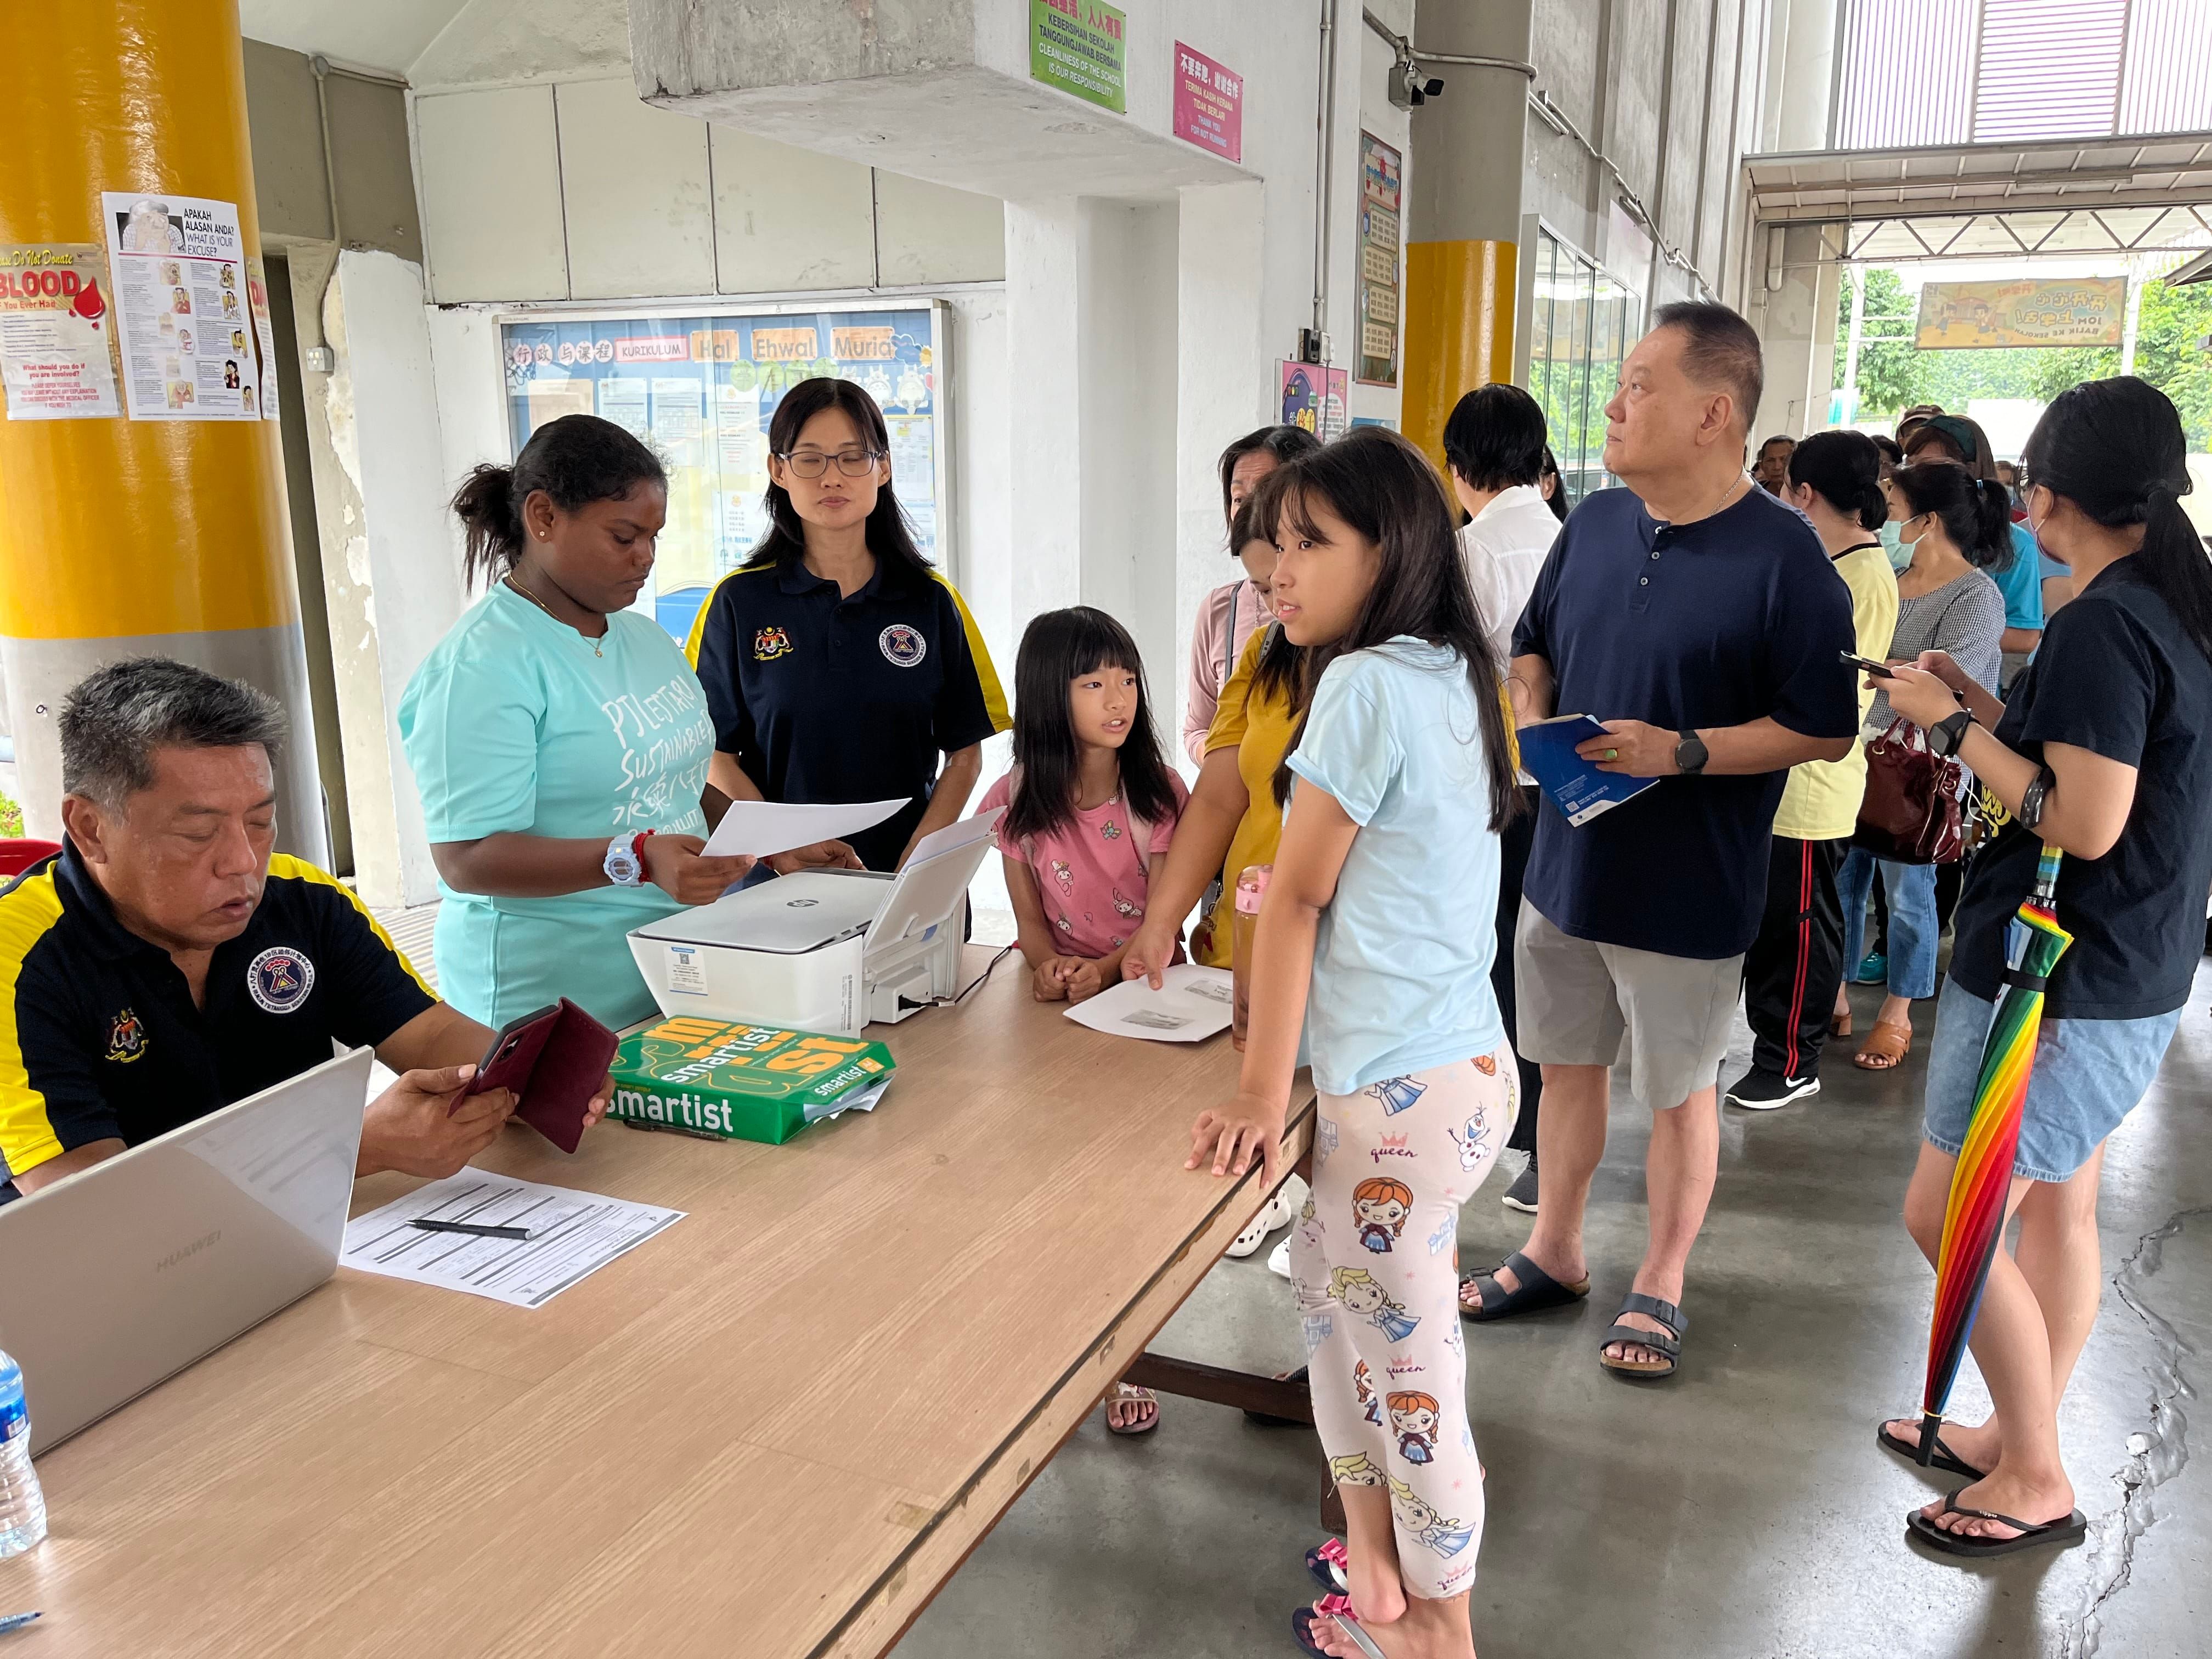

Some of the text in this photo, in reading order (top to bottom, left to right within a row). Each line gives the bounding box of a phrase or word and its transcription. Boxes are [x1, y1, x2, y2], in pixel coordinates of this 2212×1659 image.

[1048, 13, 1114, 54] KEBERSIHAN SEKOLAH
[1039, 24, 1121, 72] TANGGUNGJAWAB BERSAMA
[1039, 42, 1121, 88] CLEANLINESS OF THE SCHOOL
[1048, 62, 1113, 98] IS OUR RESPONSIBILITY
[1185, 80, 1233, 112] TERIMA KASIH KERANA
[1193, 98, 1225, 121] TIDAK BERLARI
[1190, 125, 1200, 136] FOR
[1200, 128, 1209, 139] NOT
[1198, 115, 1212, 128] THANK
[184, 208, 212, 221] APAKAH
[185, 221, 234, 236] ALASAN ANDA?
[186, 233, 233, 247] WHAT IS YOUR
[13, 250, 25, 266] Do
[26, 250, 41, 266] Not
[42, 250, 73, 266] Donate
[188, 245, 217, 257] EXCUSE?
[4, 301, 18, 309] You
[20, 300, 36, 309] Ever
[517, 343, 609, 363] 行政与课程
[622, 344, 681, 357] KURIKULUM
[699, 338, 730, 359] Hal
[757, 337, 814, 358] Ehwal
[614, 720, 708, 791] SUSTAINABLE
[661, 1027, 782, 1083] smartist
[814, 1065, 867, 1096] smartist
[1371, 1146, 1418, 1164] queen
[157, 1229, 222, 1273] HUAWEI
[1386, 1365, 1426, 1380] queen
[1437, 1565, 1472, 1590] queen
